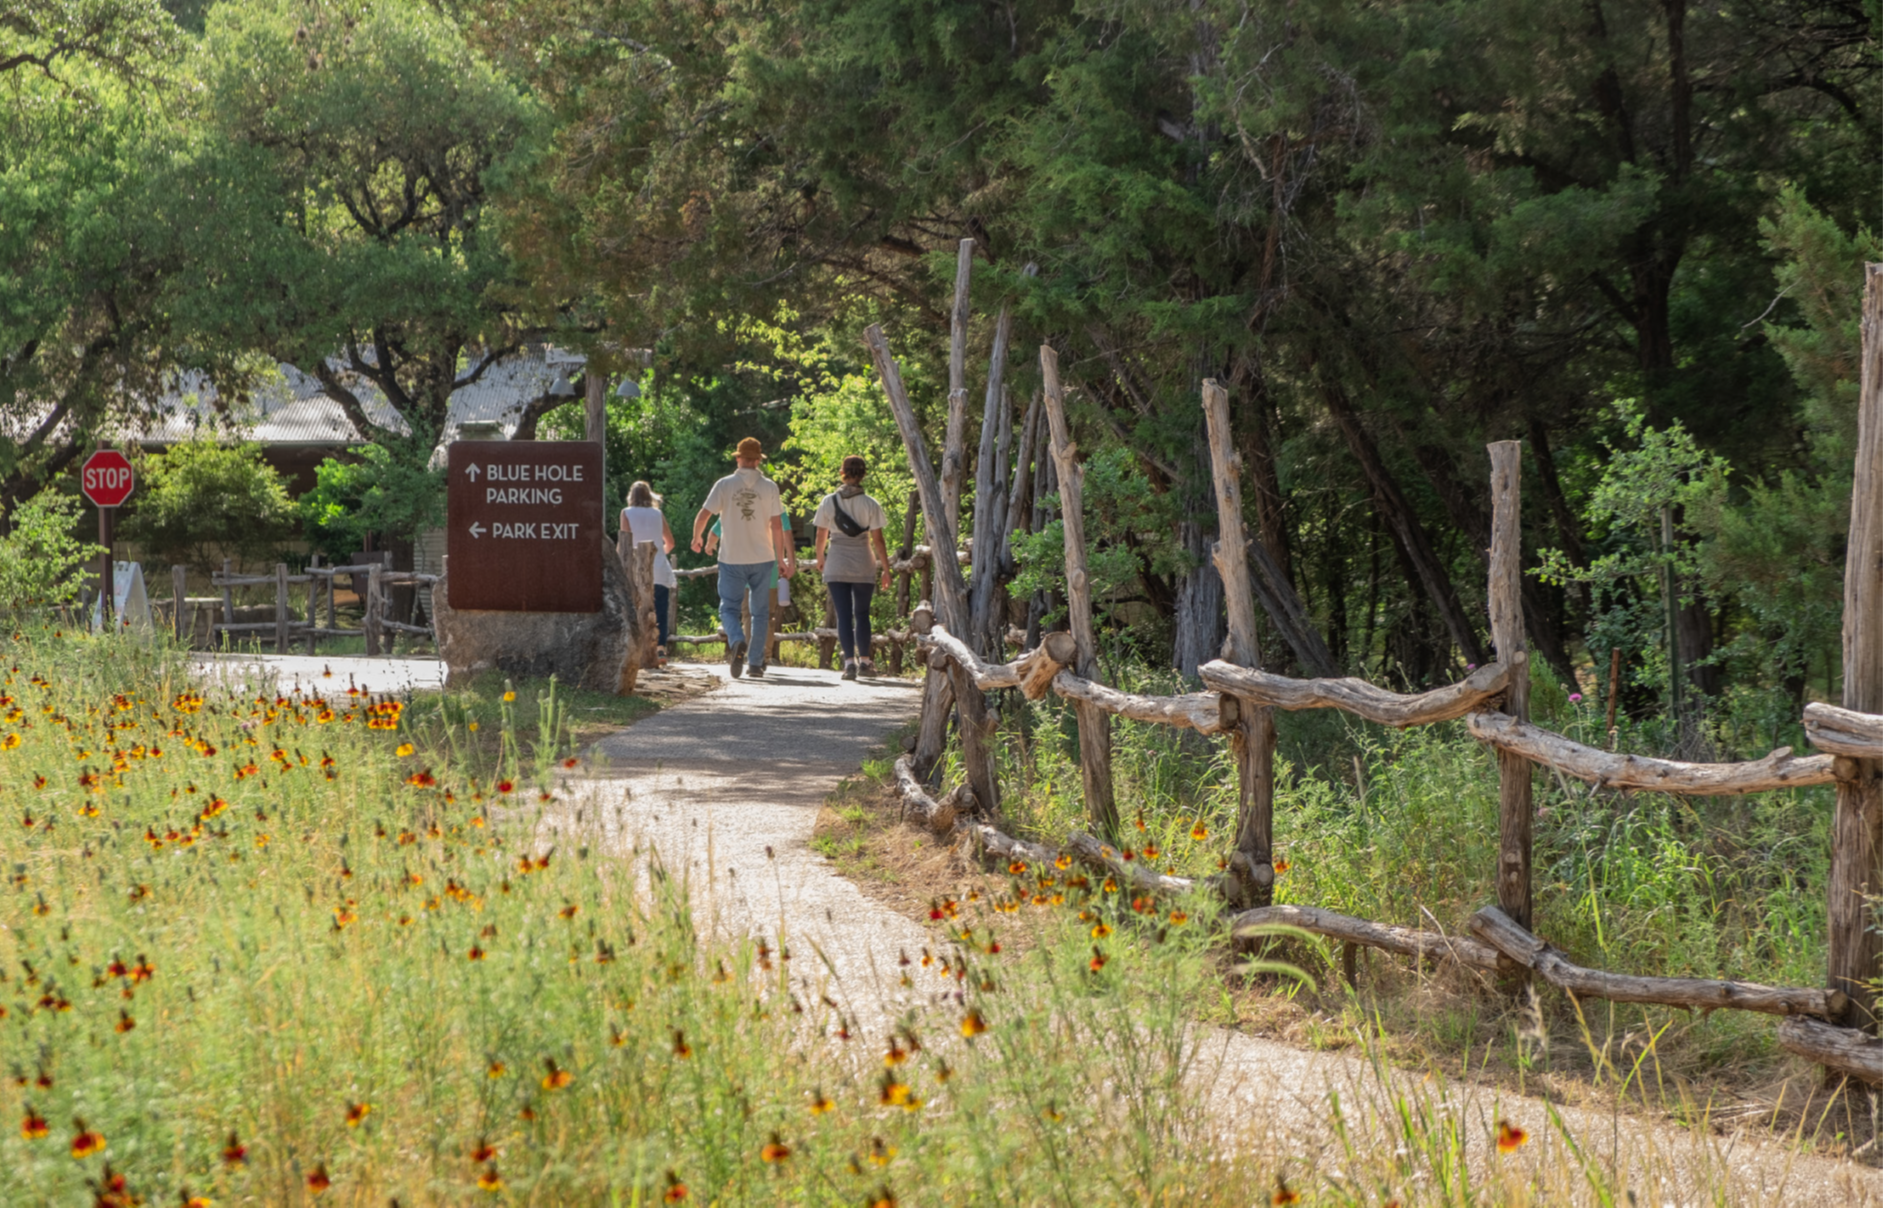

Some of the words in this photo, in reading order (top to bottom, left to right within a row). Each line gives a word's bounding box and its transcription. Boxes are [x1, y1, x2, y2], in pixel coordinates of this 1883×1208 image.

[85, 467, 130, 490] STOP
[486, 464, 531, 481] BLUE
[534, 464, 584, 482] HOLE
[486, 487, 563, 505] PARKING
[492, 522, 537, 540] PARK
[540, 523, 580, 540] EXIT
